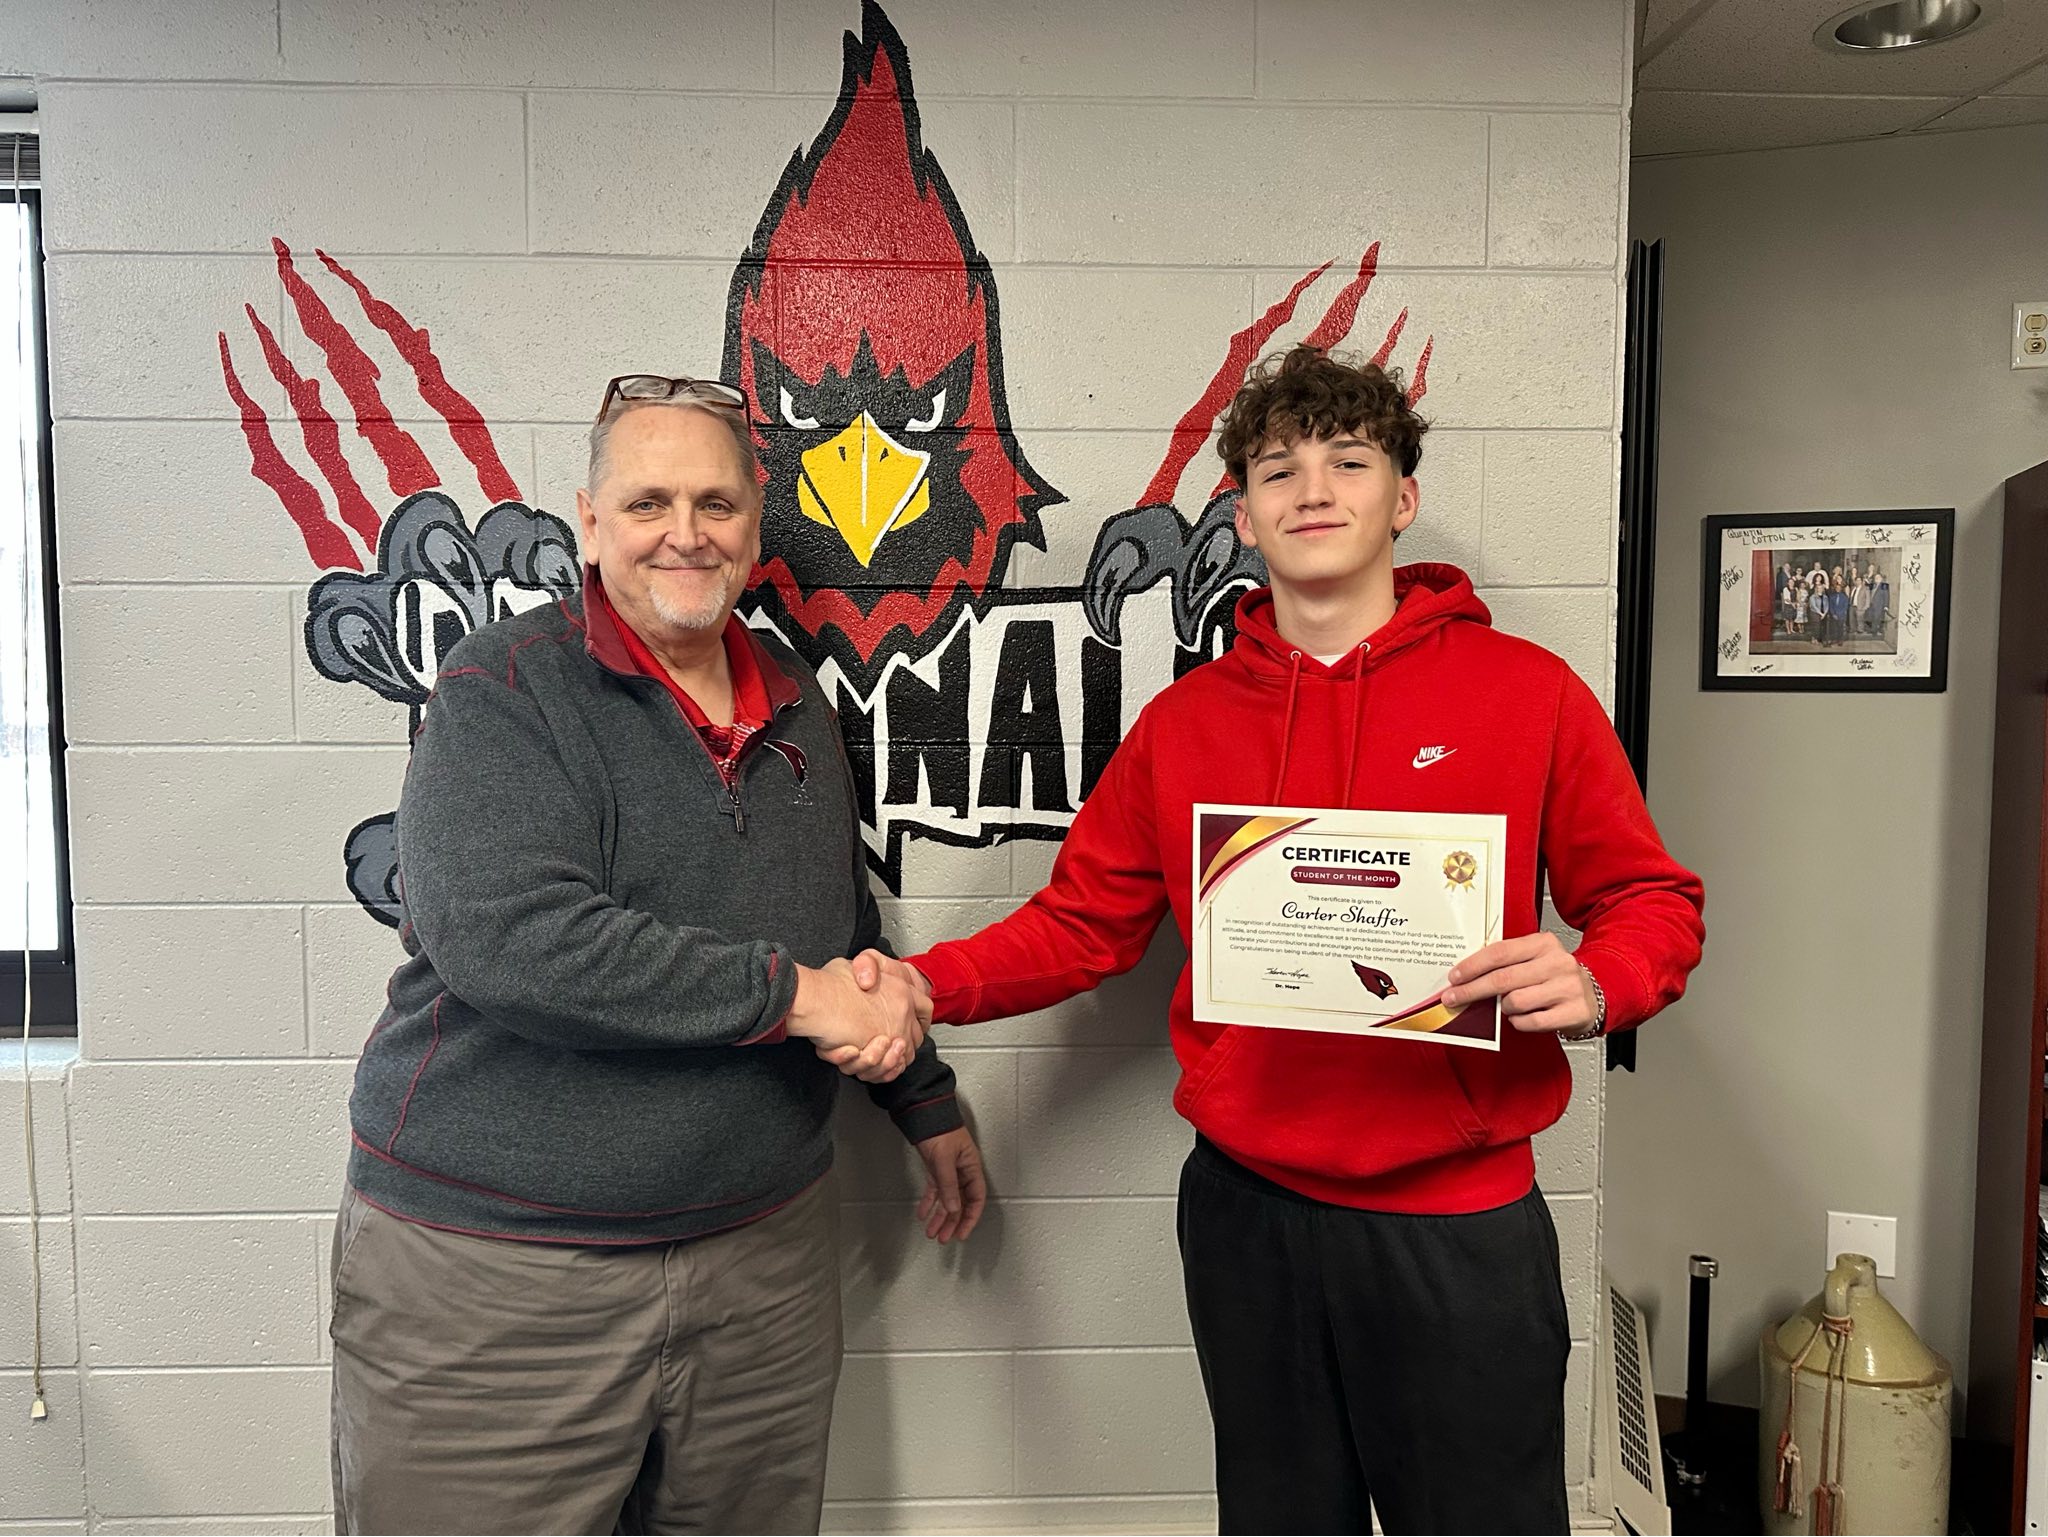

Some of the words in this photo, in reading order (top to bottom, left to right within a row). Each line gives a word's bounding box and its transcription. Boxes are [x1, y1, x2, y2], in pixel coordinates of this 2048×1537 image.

[1752, 533, 1785, 545] COTTON
[1418, 746, 1446, 760] NIKE
[1282, 846, 1411, 865] CERTIFICATE
[1293, 871, 1330, 879] STUDENT
[1282, 901, 1337, 921] Carter
[1340, 905, 1409, 928] Shaffer
[1272, 922, 1306, 931] outstanding
[1230, 944, 1274, 952] Congratulations
[1284, 948, 1300, 956] being
[1321, 943, 1352, 951] encourage
[1400, 948, 1422, 957] striving
